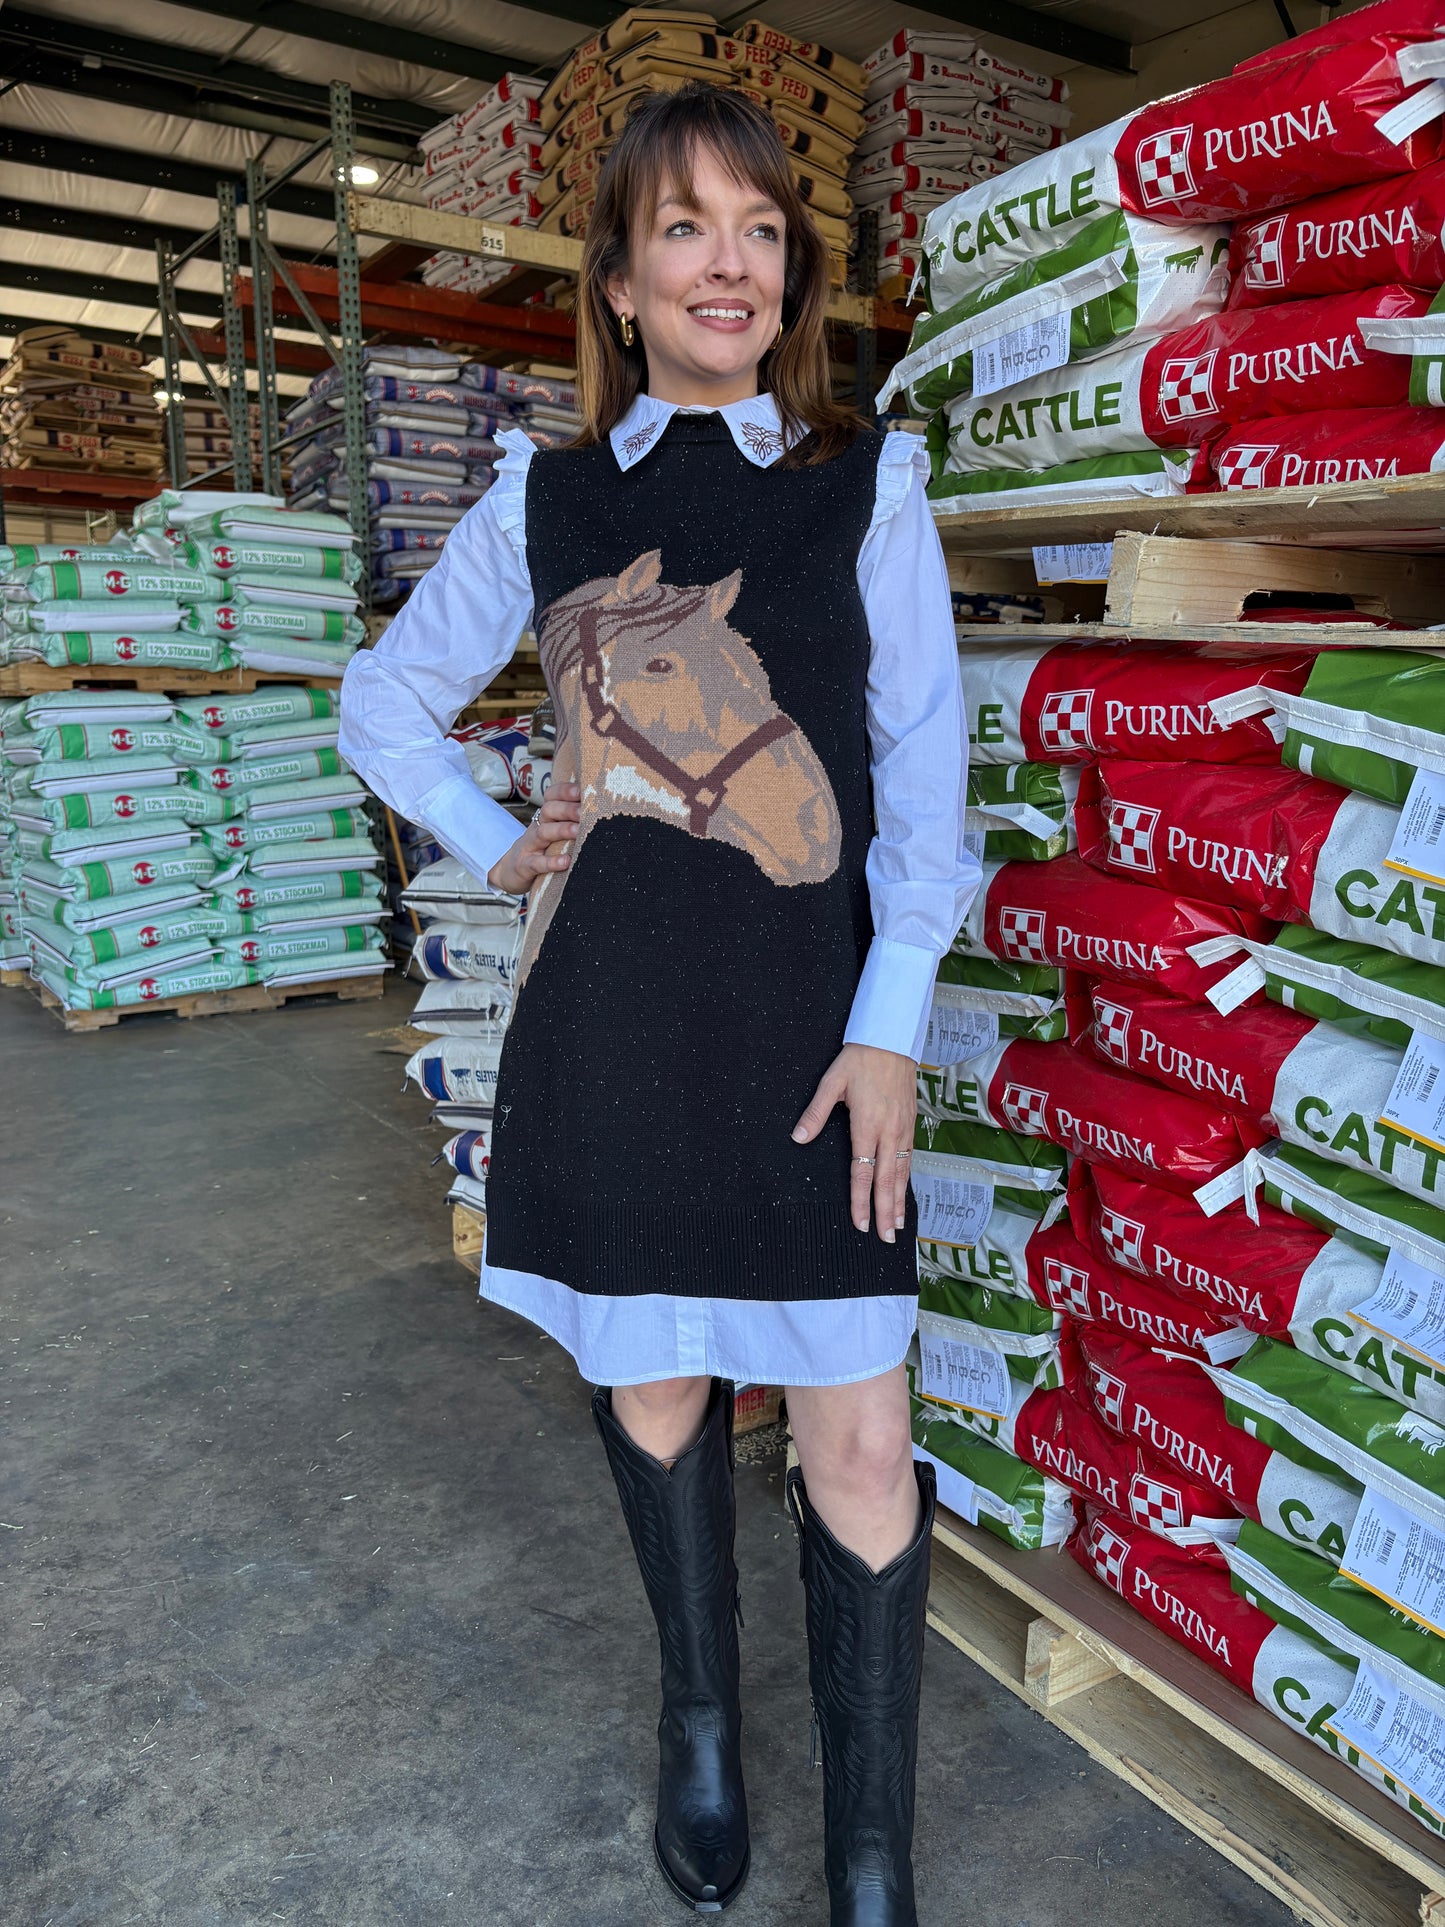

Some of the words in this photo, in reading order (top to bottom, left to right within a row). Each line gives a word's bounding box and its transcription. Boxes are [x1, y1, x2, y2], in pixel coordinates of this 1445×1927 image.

[781, 76, 808, 100] FEED
[1203, 100, 1338, 171] PURINA
[953, 167, 1101, 263] CATTLE
[482, 236, 503, 250] 615
[1296, 206, 1420, 263] PURINA
[1227, 334, 1364, 392] PURINA
[970, 381, 1123, 447] CATTLE
[243, 552, 260, 563] 12%
[139, 577, 157, 590] 12%
[245, 614, 262, 625] 12%
[148, 643, 165, 656] 12%
[234, 708, 251, 721] 12%
[1105, 701, 1232, 741] PURINA
[144, 734, 161, 746] 12%
[242, 770, 259, 783] 12%
[146, 799, 163, 811] 12%
[256, 829, 273, 841] 12%
[274, 824, 314, 838] STOCKMAN
[165, 864, 182, 876] 12%
[1167, 827, 1287, 890] PURINA
[266, 891, 283, 902] 12%
[284, 884, 324, 898] STOCKMAN
[169, 927, 187, 939] 12%
[269, 945, 286, 956] 12%
[287, 940, 328, 953] STOCKMAN
[1056, 926, 1172, 972] PURINA
[169, 980, 187, 992] 12%
[1138, 1029, 1249, 1105] PURINA
[1055, 1108, 1160, 1170] PURINA
[1153, 1244, 1269, 1322] PURINA
[1098, 1290, 1208, 1352] PURINA
[1313, 1317, 1445, 1401] CAT
[1132, 1405, 1236, 1495] PURINA
[1031, 1434, 1120, 1510] PURINA
[1134, 1567, 1234, 1668] PURINA
